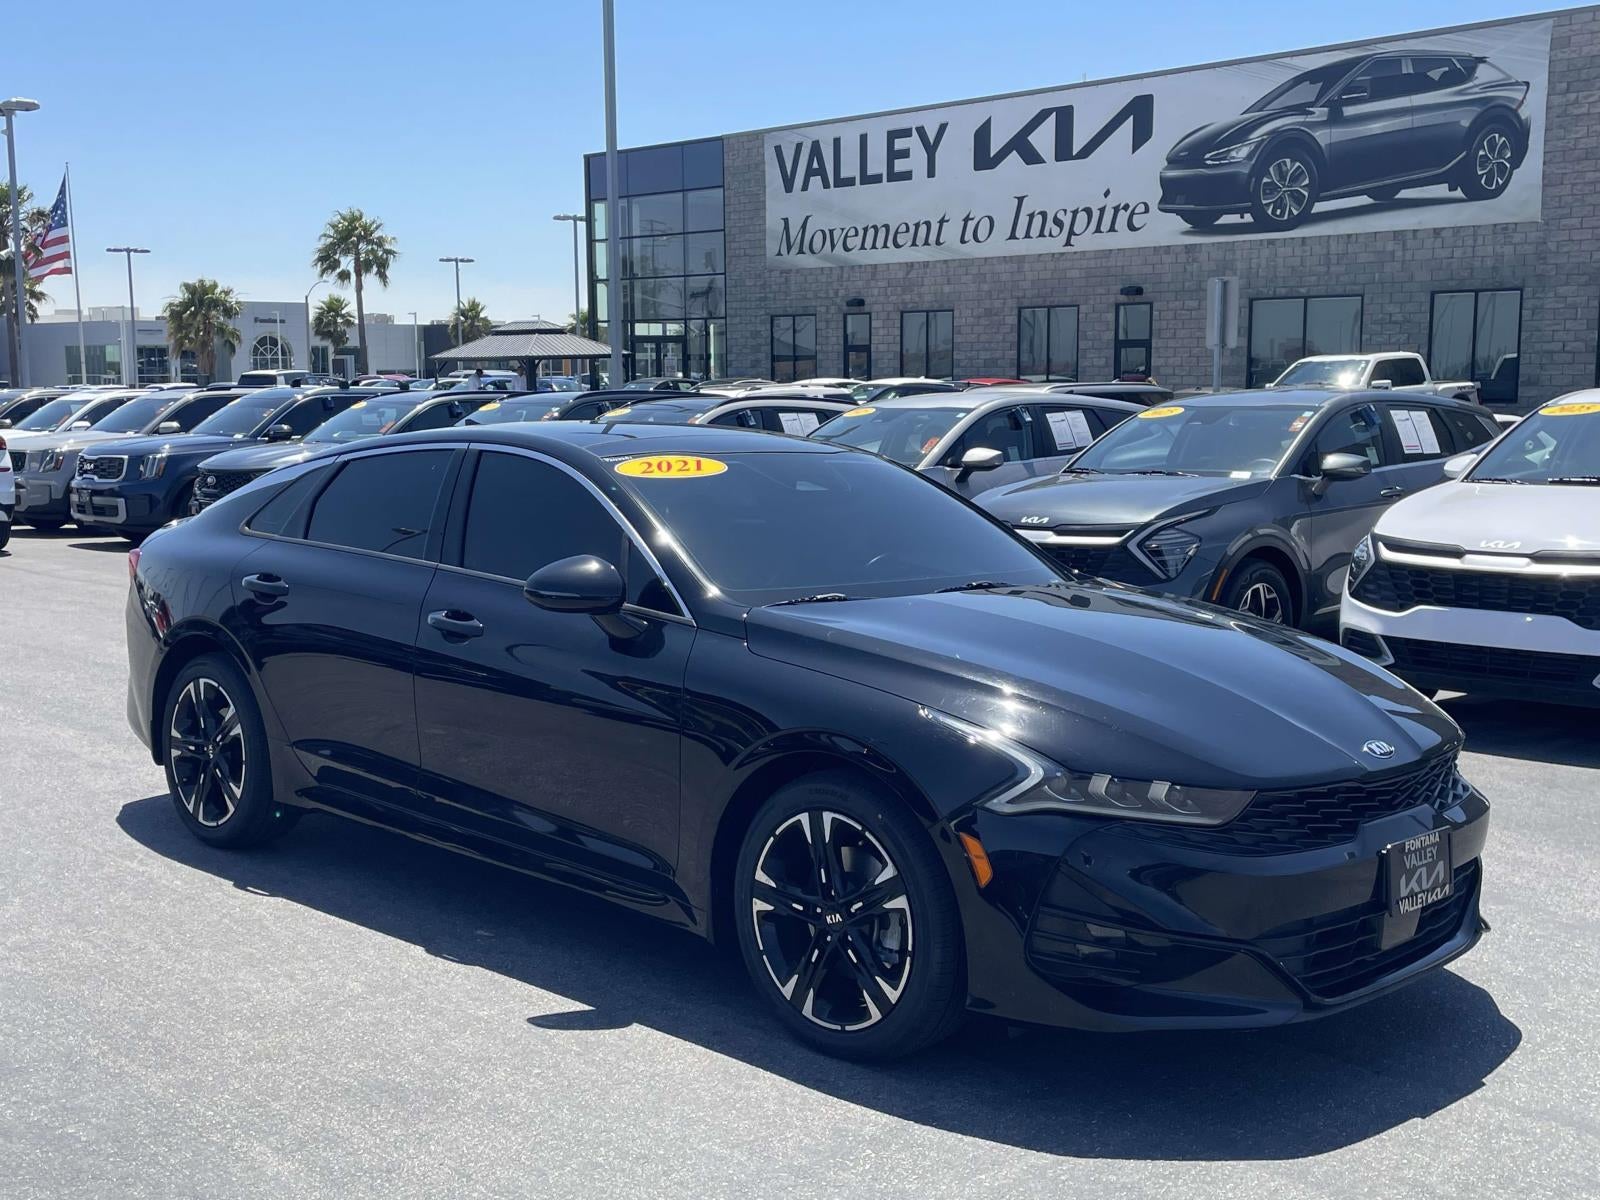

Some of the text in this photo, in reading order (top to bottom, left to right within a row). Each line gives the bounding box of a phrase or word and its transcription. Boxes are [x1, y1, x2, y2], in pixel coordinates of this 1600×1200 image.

[774, 93, 1154, 194] VALLEY KIA
[775, 188, 1150, 258] Movement to Inspire
[639, 459, 704, 475] 2021
[1367, 741, 1391, 755] KIA
[1405, 831, 1440, 853] FONTANA
[1403, 845, 1438, 870] VALLEY
[1400, 860, 1445, 898] KIA
[1398, 891, 1428, 915] VALLEY
[825, 913, 843, 925] KIA
